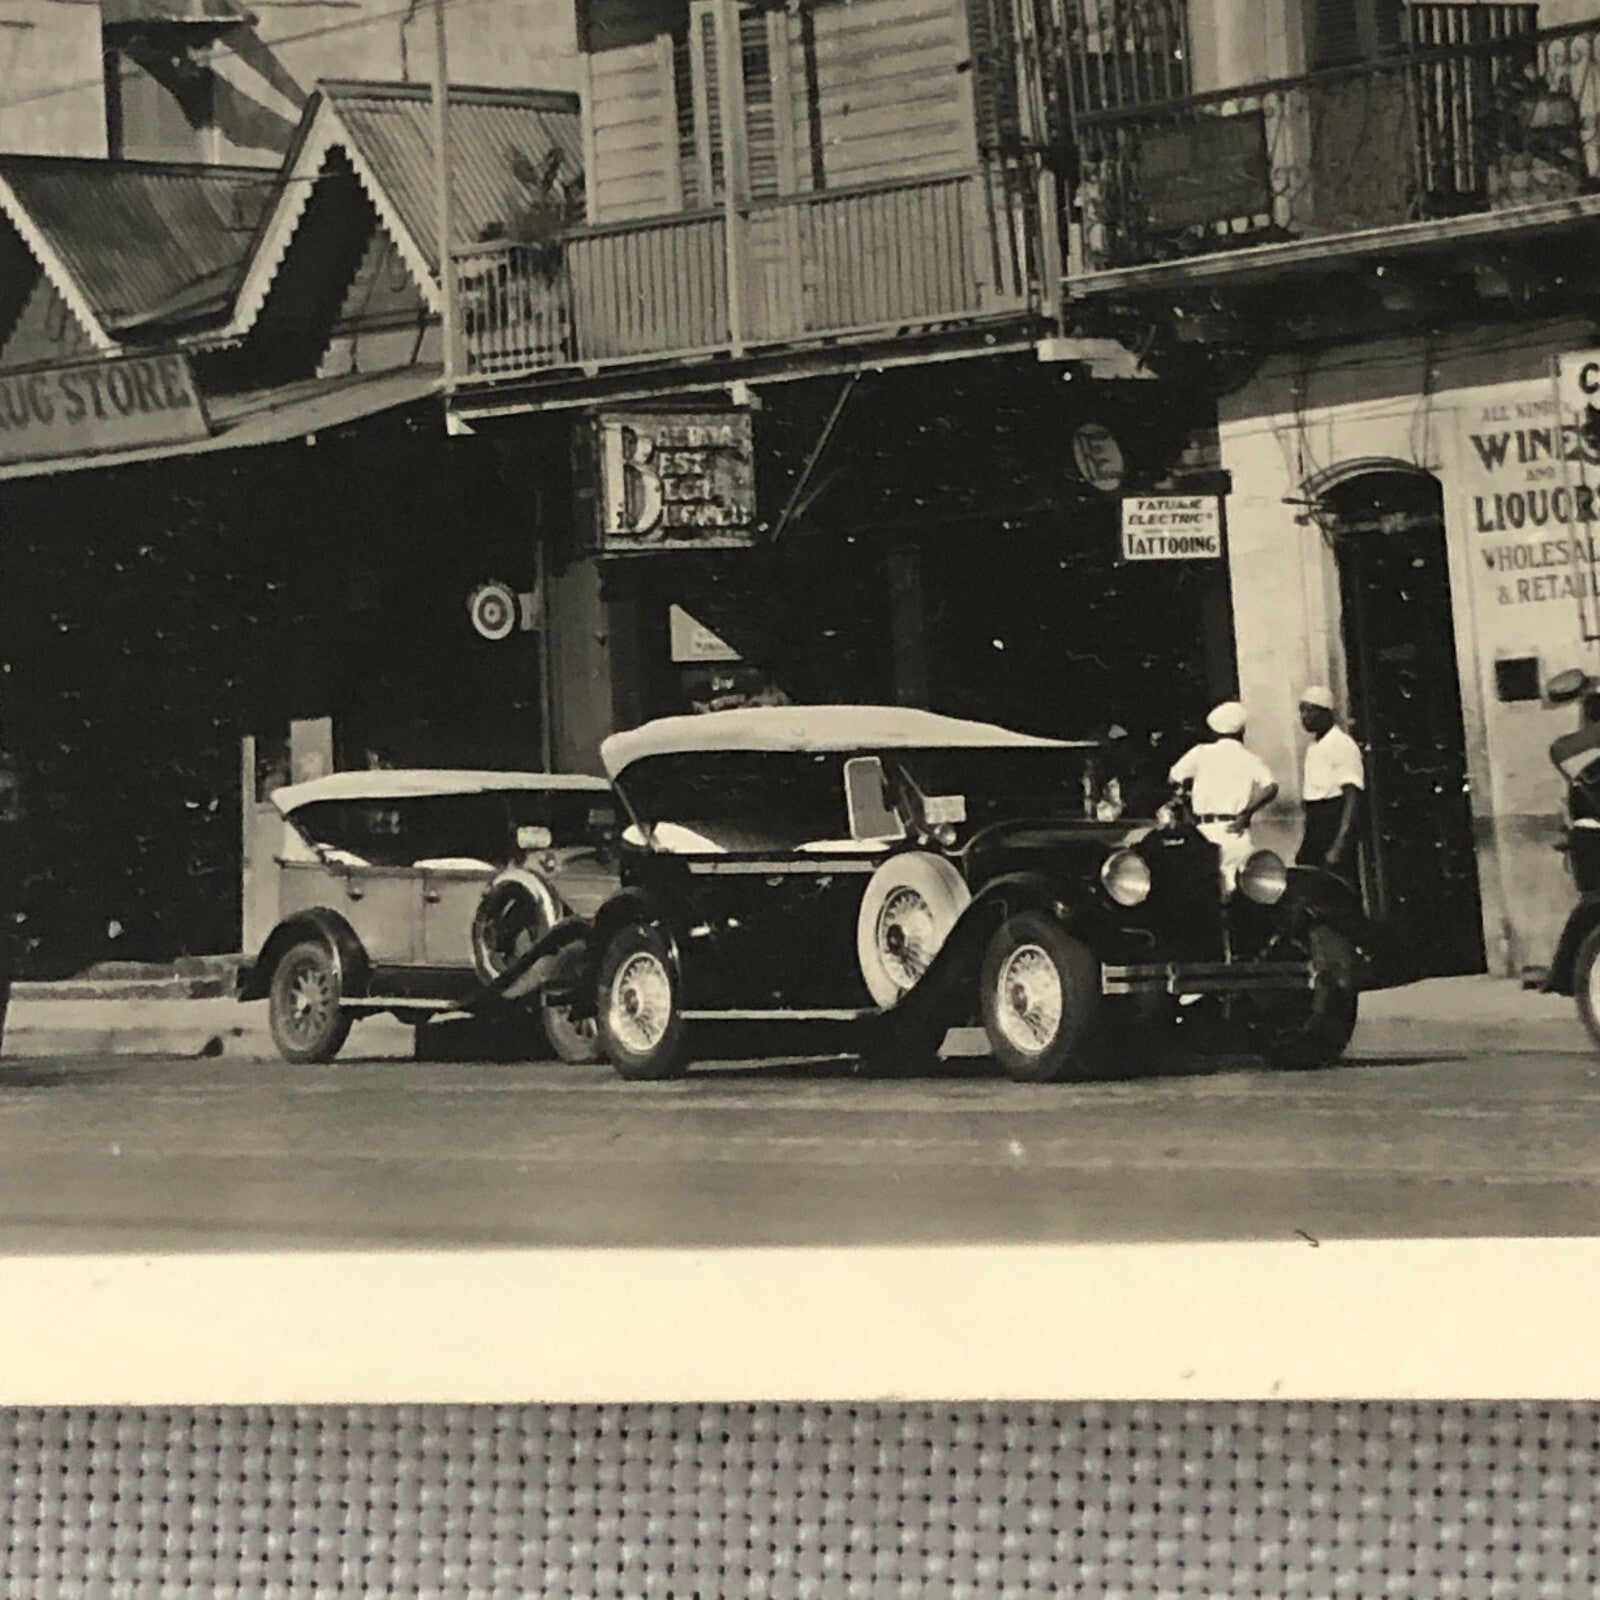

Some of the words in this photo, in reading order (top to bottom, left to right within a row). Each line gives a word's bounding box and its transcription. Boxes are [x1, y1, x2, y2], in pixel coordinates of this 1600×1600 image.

[0, 374, 55, 431] UG
[58, 353, 192, 426] STORE
[1127, 534, 1216, 555] TATTOOING
